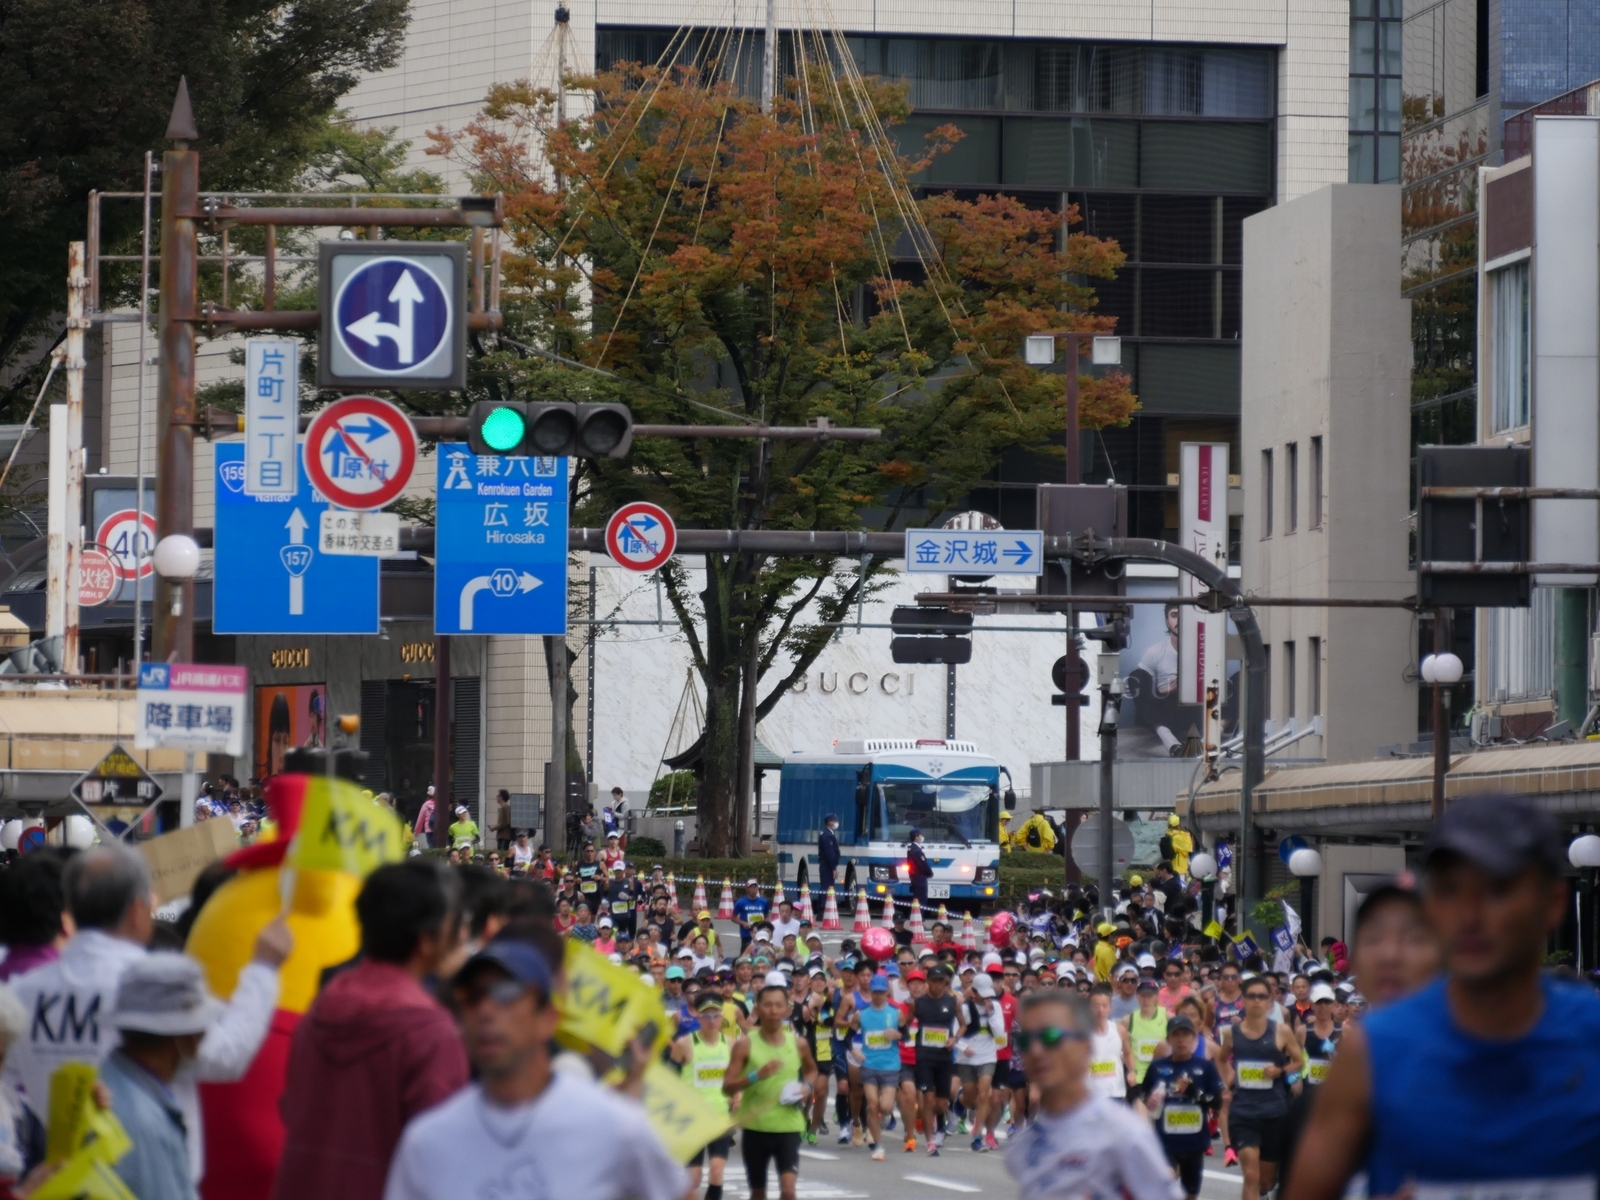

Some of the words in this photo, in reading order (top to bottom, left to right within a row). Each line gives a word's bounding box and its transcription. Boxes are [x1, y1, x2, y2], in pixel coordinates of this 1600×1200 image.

[258, 348, 285, 487] 片町一丁目
[224, 466, 245, 480] 159
[341, 456, 390, 480] 原付
[477, 482, 520, 496] Kenrokuen
[523, 482, 552, 496] Garden
[483, 502, 549, 527] 広坂
[323, 518, 362, 531] この先
[113, 530, 149, 560] 40
[323, 533, 394, 551] 香林坊交差点
[486, 530, 545, 544] Hirosaka
[630, 540, 659, 554] 原付
[916, 539, 998, 565] 金沢城
[285, 551, 308, 566] 157
[79, 567, 111, 590] 火栓
[493, 573, 514, 592] 10
[271, 649, 310, 668] GUCCI
[401, 643, 436, 663] GUCC
[146, 702, 233, 734] 降車場
[866, 934, 895, 948] 3:00
[31, 991, 101, 1043] KM
